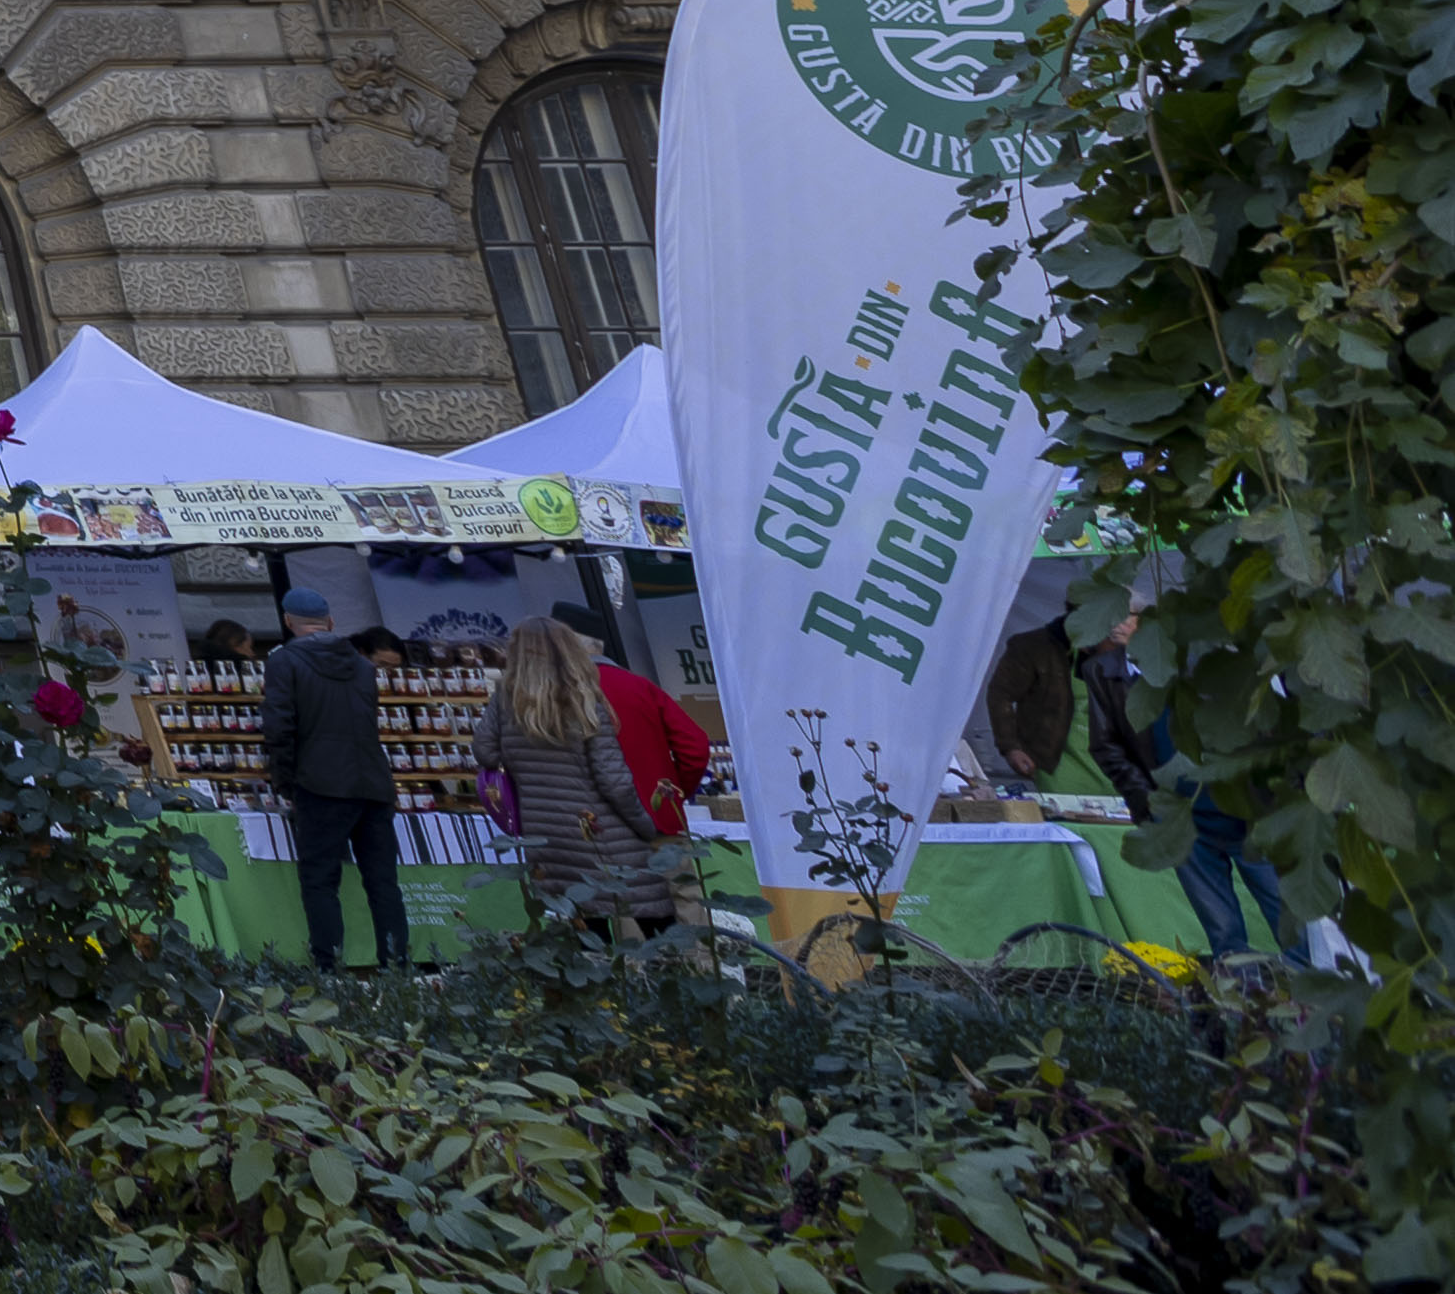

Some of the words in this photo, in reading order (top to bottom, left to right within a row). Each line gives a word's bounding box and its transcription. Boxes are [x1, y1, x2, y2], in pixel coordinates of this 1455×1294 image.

[787, 23, 888, 136] GUSTĂ
[898, 121, 975, 175] DIN
[845, 288, 910, 363] DIN
[248, 485, 270, 501] de
[271, 485, 288, 500] la
[444, 485, 506, 501] Zacuscă
[211, 507, 256, 522] inima
[463, 519, 524, 537] Siropuri
